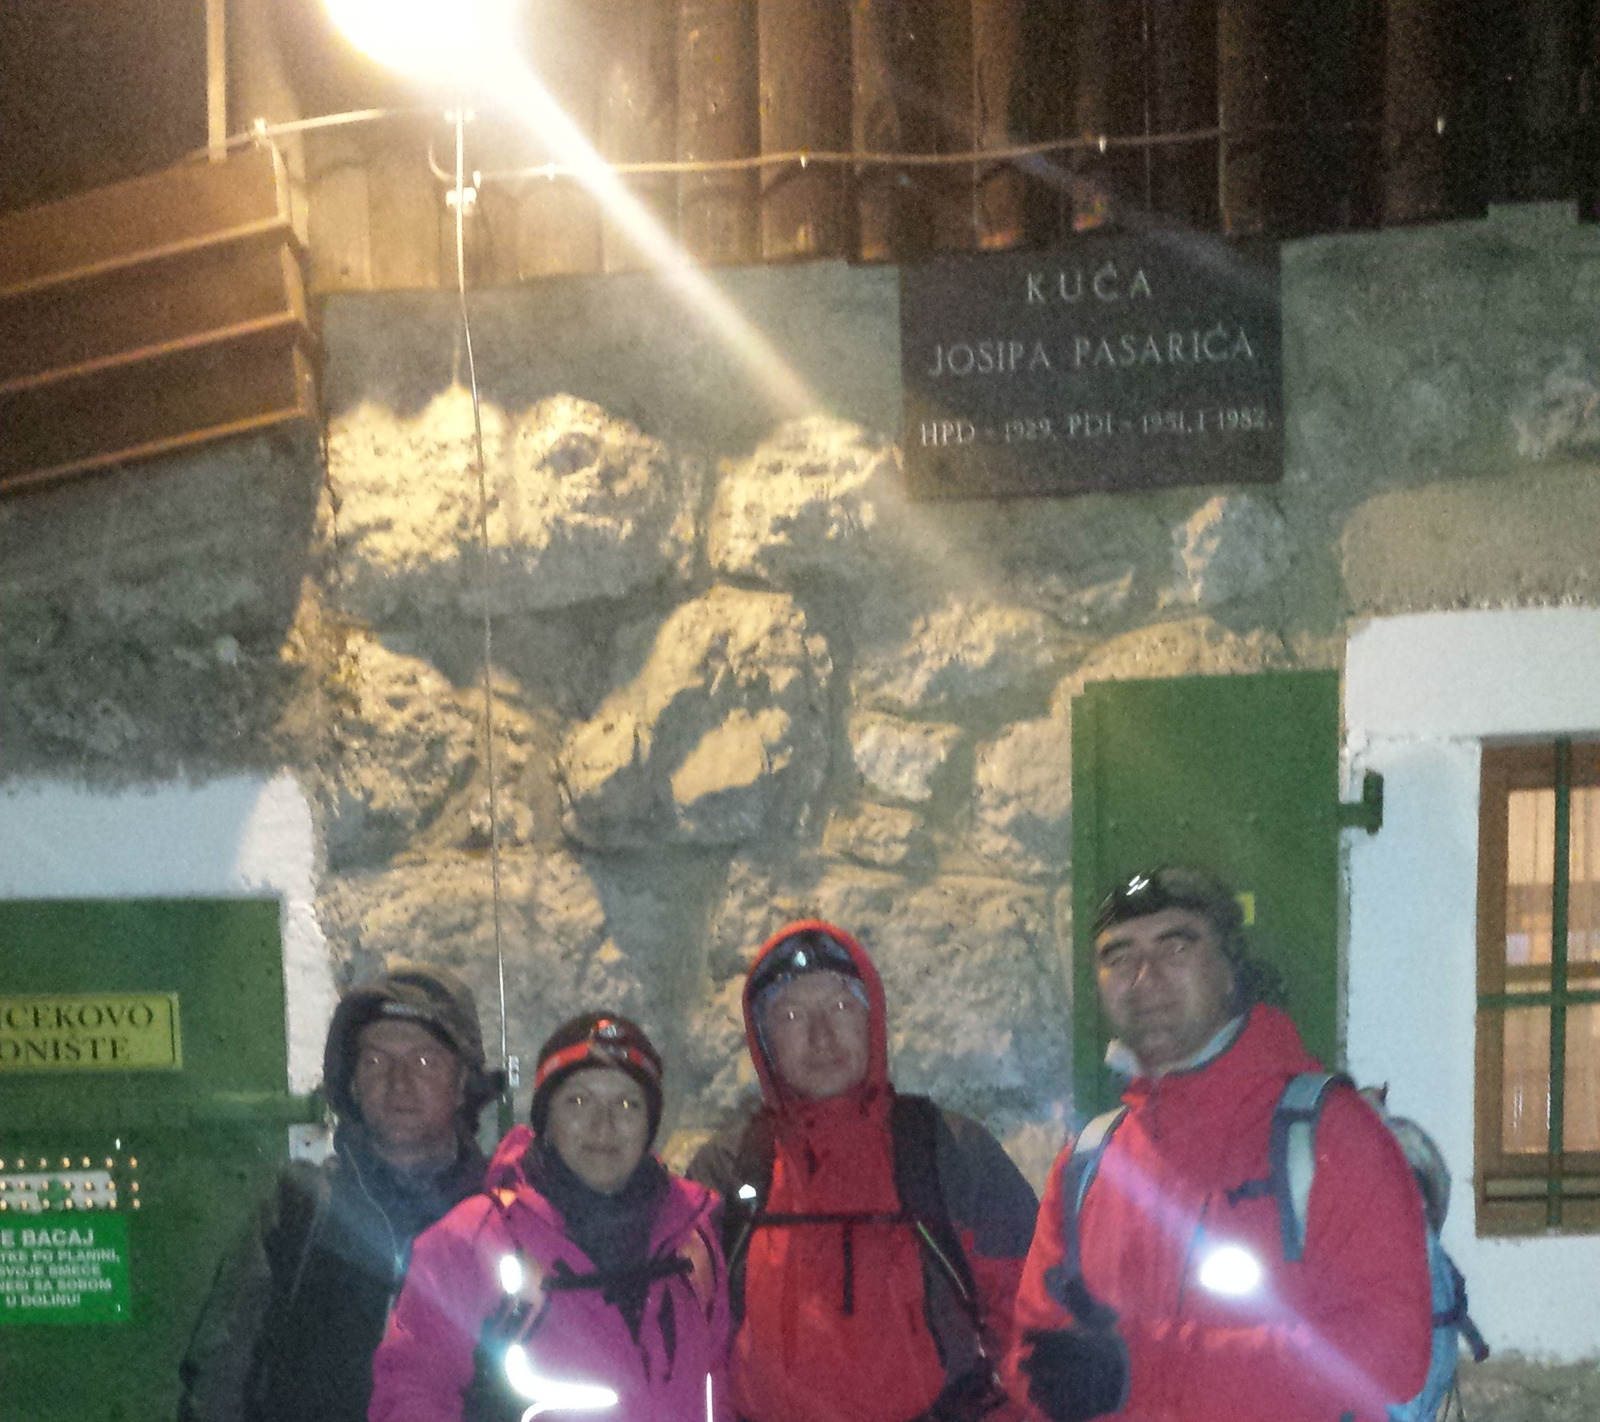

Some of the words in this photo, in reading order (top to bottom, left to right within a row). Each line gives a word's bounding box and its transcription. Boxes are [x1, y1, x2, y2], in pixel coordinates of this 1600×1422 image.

[1026, 260, 1153, 303] KUĆA
[927, 339, 1052, 377] JOSIPA
[1073, 323, 1254, 368] PASARIĆA
[920, 420, 975, 447] HPD
